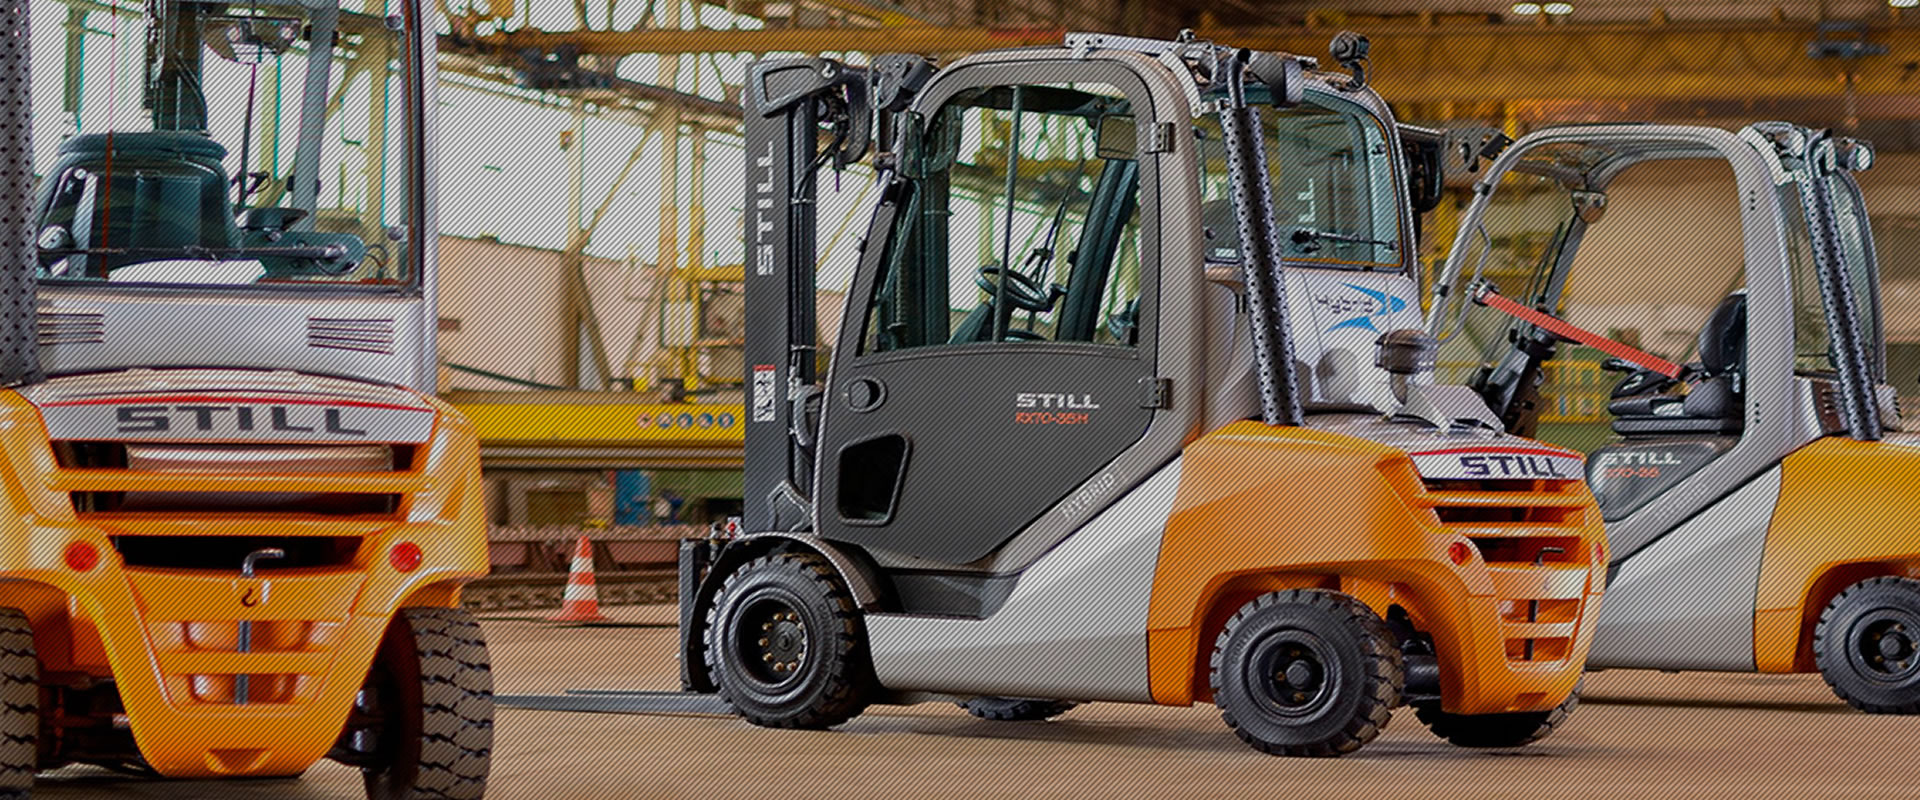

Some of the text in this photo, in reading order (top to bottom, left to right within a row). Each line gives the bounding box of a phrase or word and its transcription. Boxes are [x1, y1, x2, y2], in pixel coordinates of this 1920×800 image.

[757, 141, 774, 275] STILL
[1314, 294, 1374, 314] Hybrid
[1016, 393, 1100, 409] STILL
[117, 406, 367, 437] STILL
[1460, 455, 1565, 478] STILL
[1600, 452, 1682, 465] STILL
[1061, 473, 1115, 518] HYBRID
